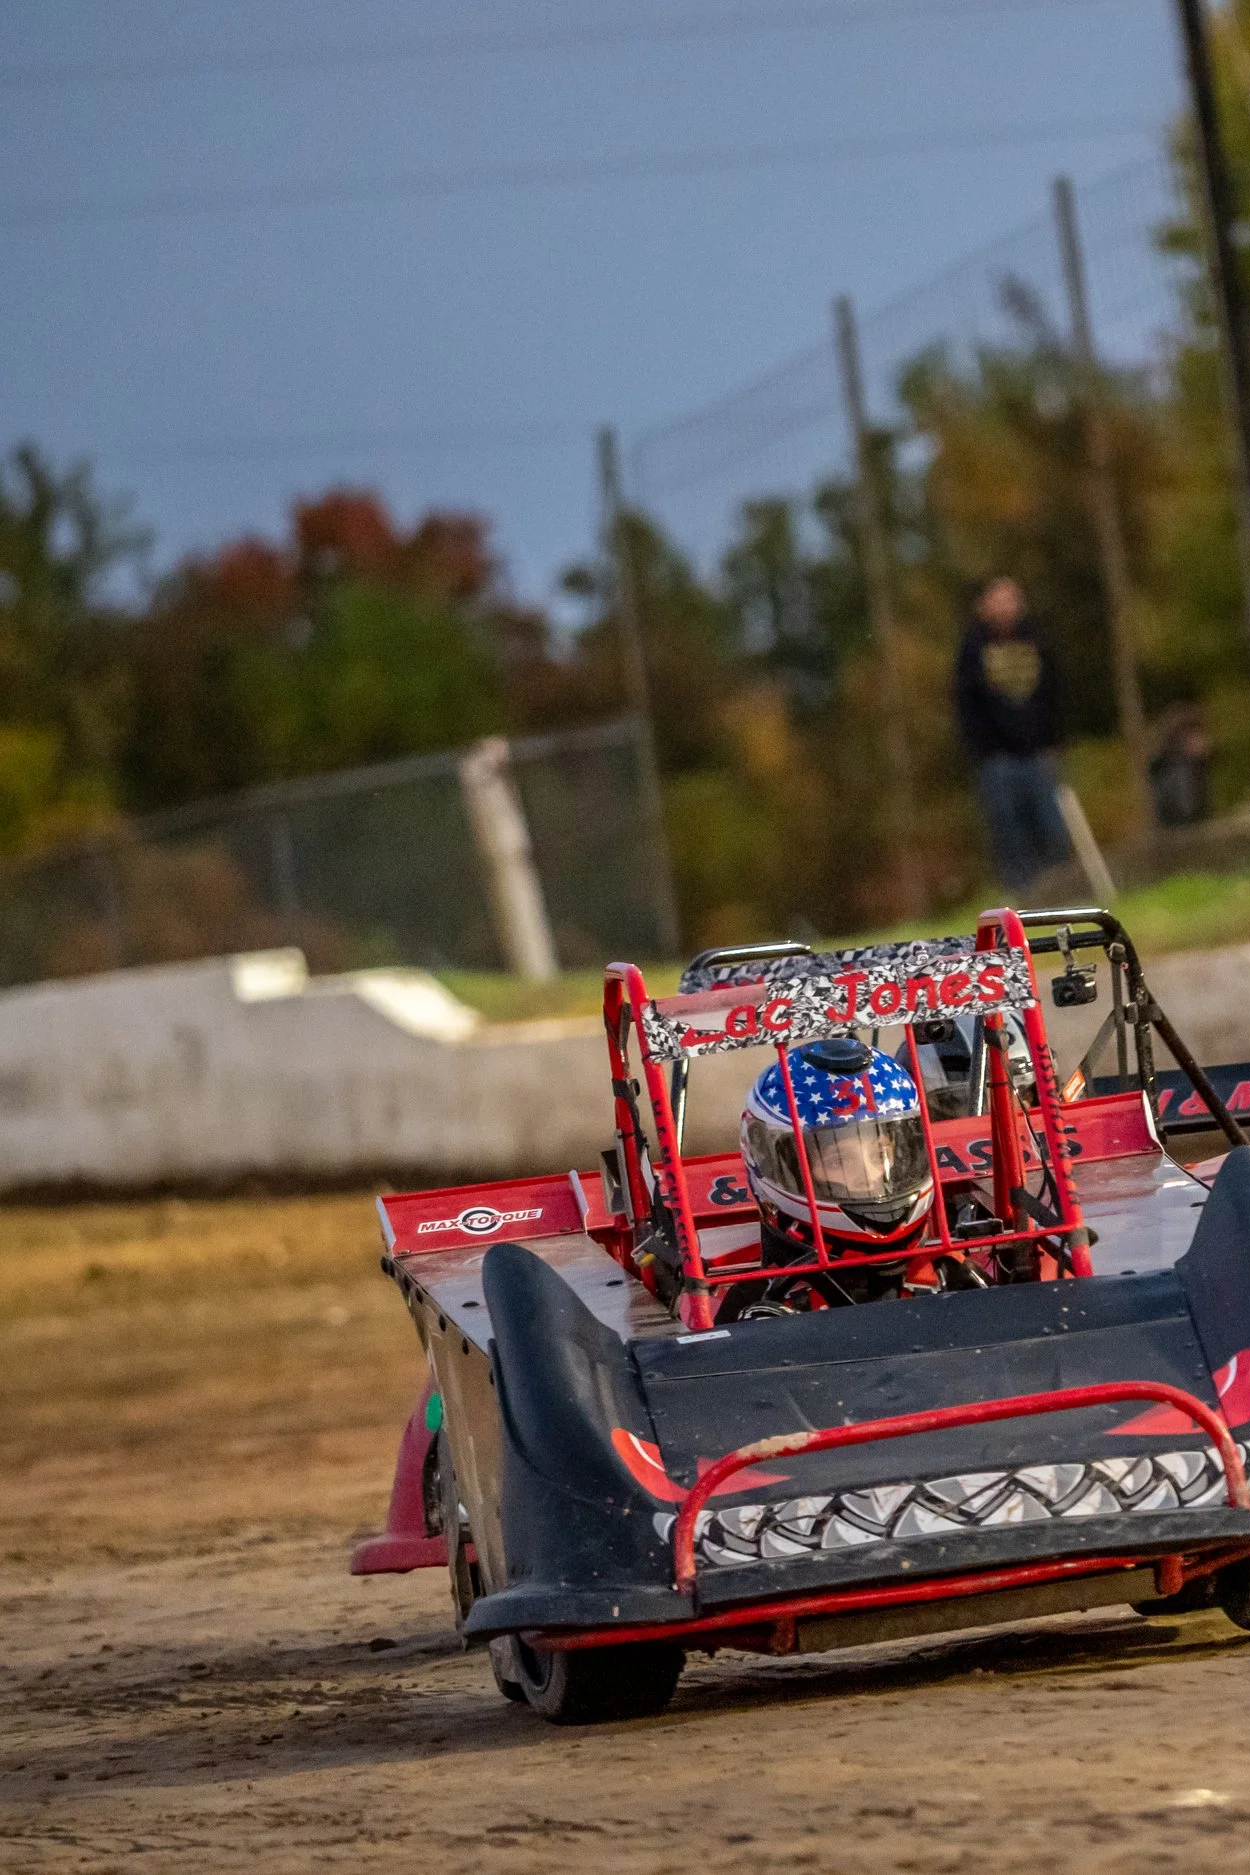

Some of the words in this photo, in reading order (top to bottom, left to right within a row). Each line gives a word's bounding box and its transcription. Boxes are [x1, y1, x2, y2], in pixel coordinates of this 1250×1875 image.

[826, 966, 1006, 1024] Jones
[829, 1073, 878, 1116] 31
[707, 1175, 751, 1206] &
[419, 1208, 539, 1233] MAX-TORQUE
